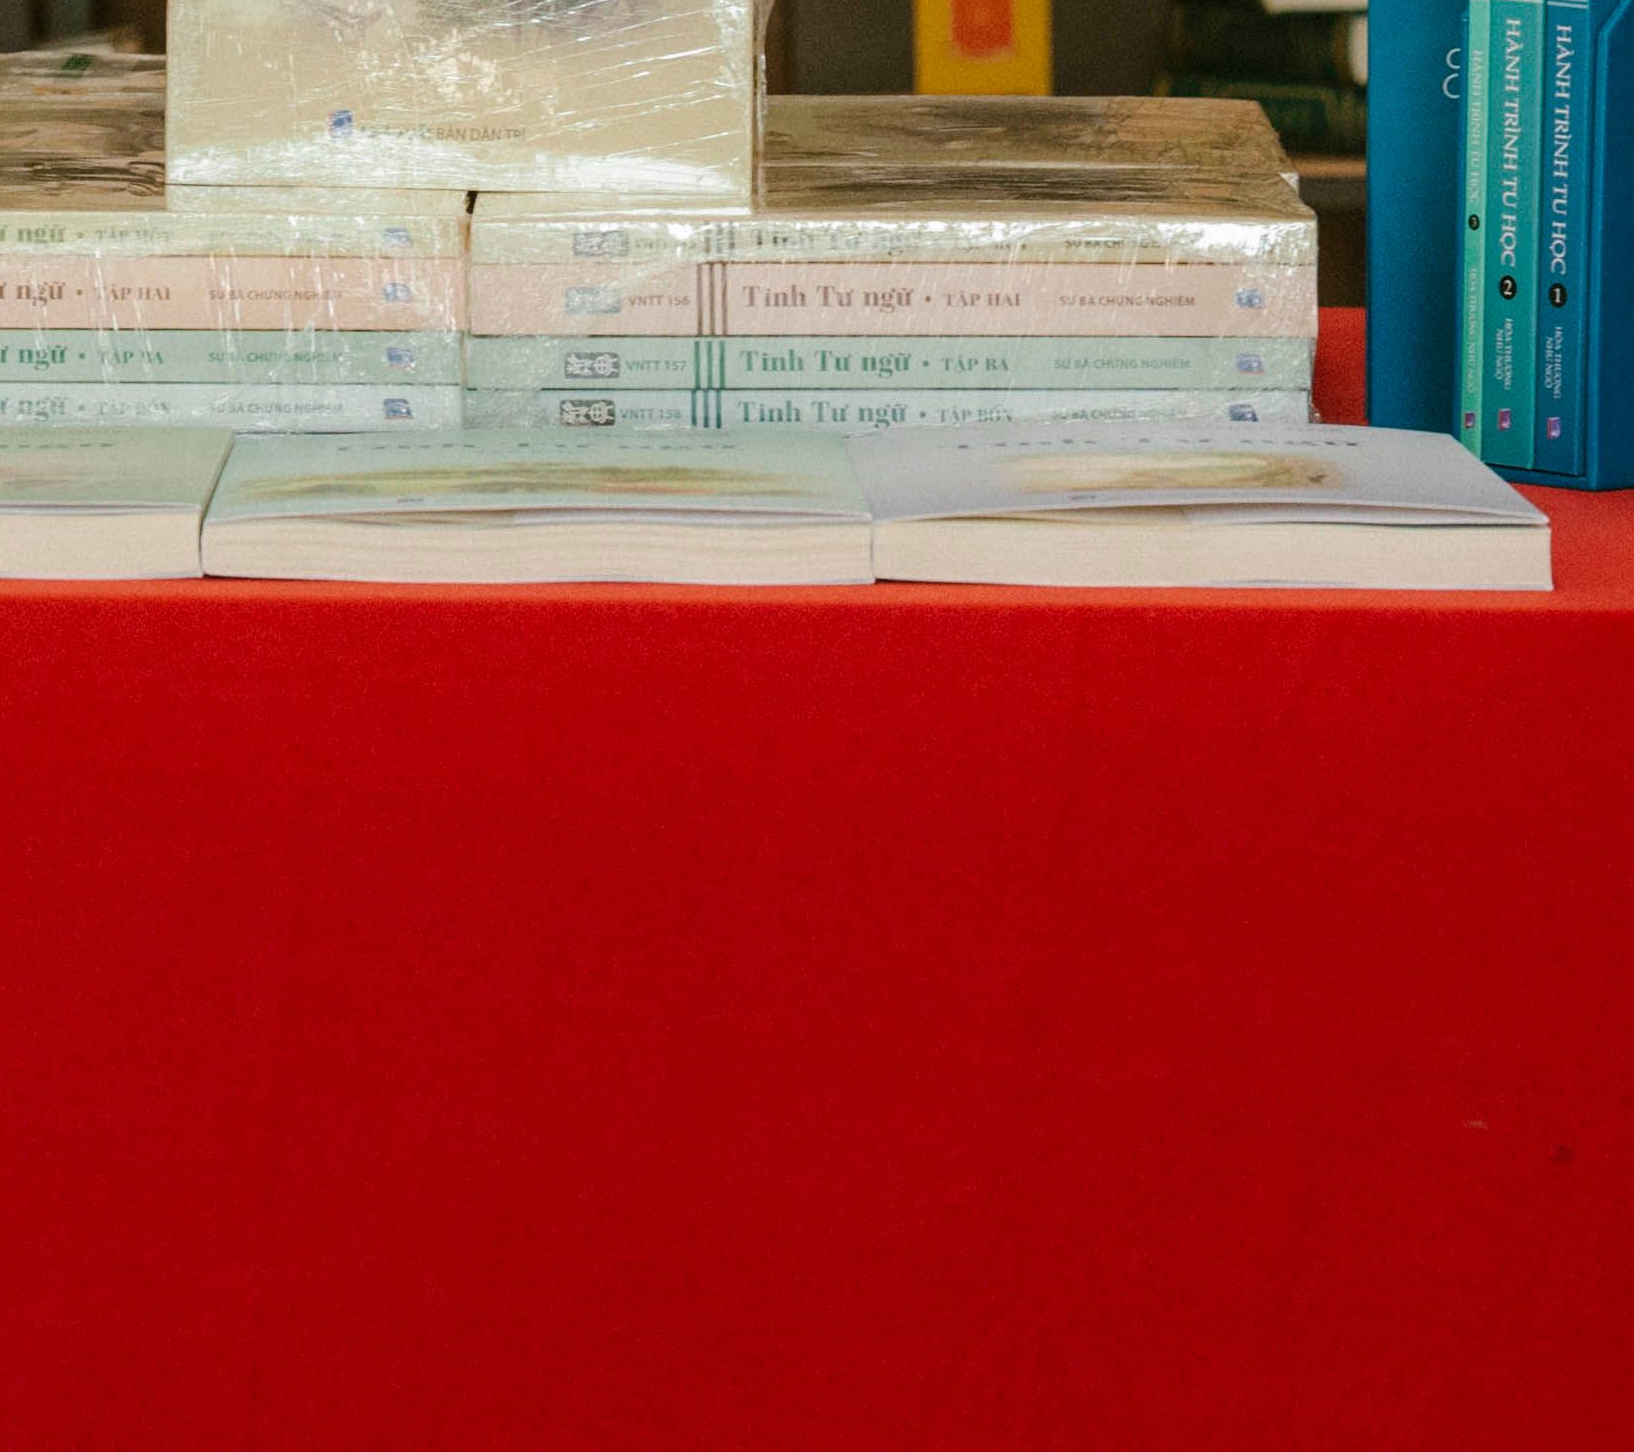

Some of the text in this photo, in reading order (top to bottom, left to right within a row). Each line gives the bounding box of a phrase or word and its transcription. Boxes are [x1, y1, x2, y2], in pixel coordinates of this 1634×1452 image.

[1498, 18, 1524, 296] HÀNH TRÌNH TU HỌC 2
[1548, 24, 1575, 303] HÀNH TRÌNH TU HỌC 1
[815, 285, 853, 307] Tư
[863, 288, 914, 313] ngữ
[987, 292, 1020, 306] HAI
[625, 359, 661, 371] VNTT
[814, 350, 851, 371] Tư
[861, 352, 912, 378] ngữ
[985, 357, 1009, 371] BA
